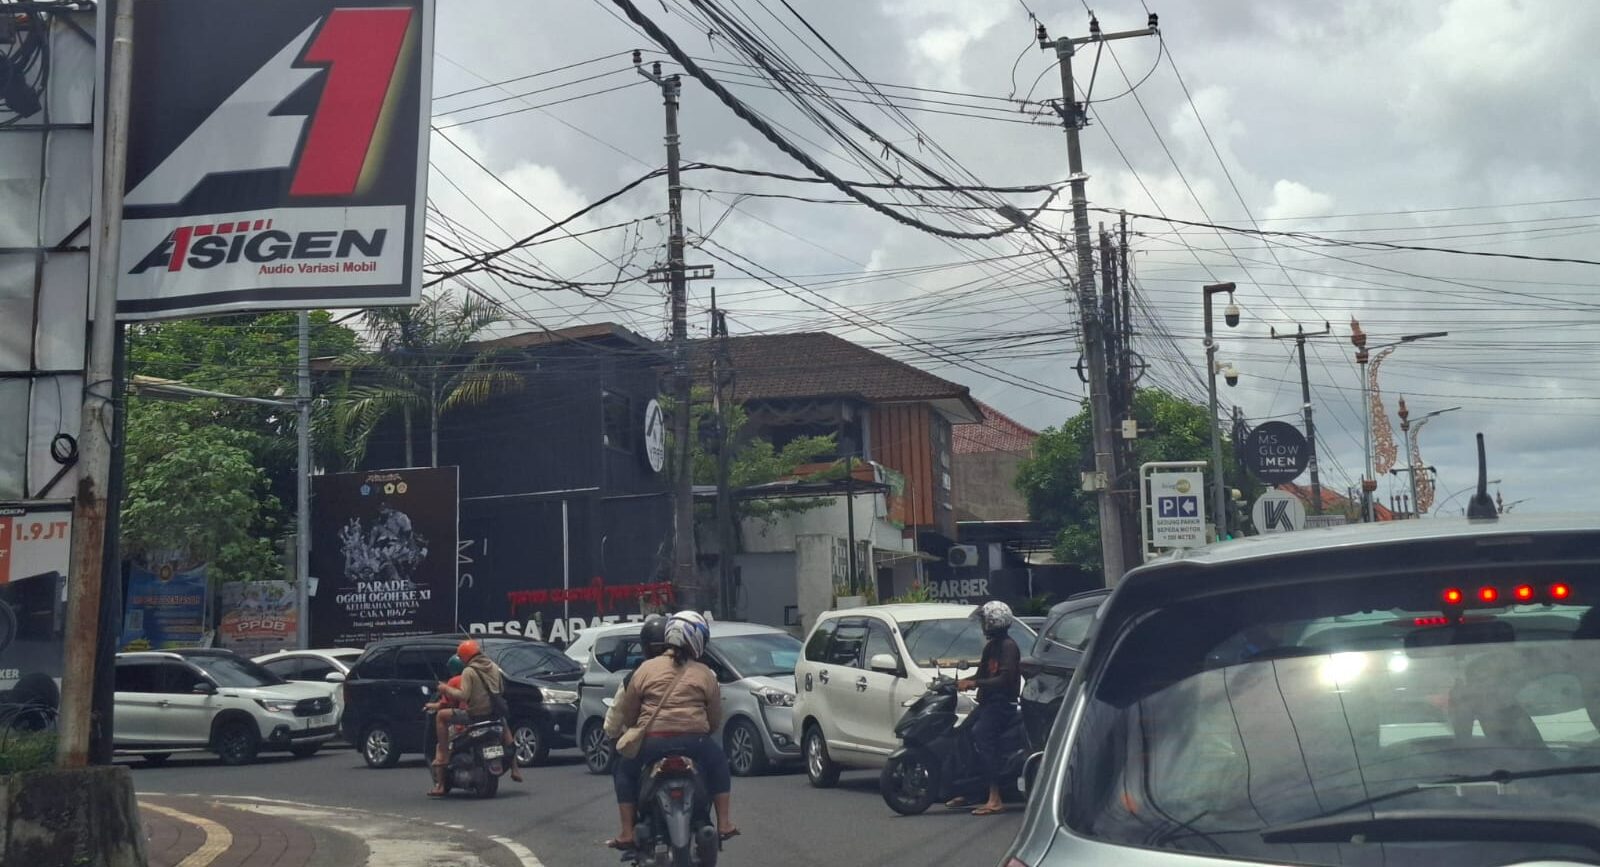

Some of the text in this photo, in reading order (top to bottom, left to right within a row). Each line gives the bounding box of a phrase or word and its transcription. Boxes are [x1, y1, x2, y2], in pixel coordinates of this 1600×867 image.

[124, 8, 412, 206] A1
[259, 261, 377, 275] Audio Variasi Mobil
[1259, 434, 1278, 444] MS
[1259, 445, 1299, 455] GLOW
[1266, 457, 1296, 466] MEN
[1163, 499, 1174, 515] P
[1264, 500, 1295, 531] K
[16, 521, 68, 541] 1.9JT
[357, 579, 409, 593] PARADE
[929, 579, 990, 597] BARBER
[336, 589, 432, 604] OGOH OGOH KE XI
[346, 602, 393, 611] KELURAHAN
[359, 608, 384, 618] CAKA
[237, 620, 287, 632] PPDB
